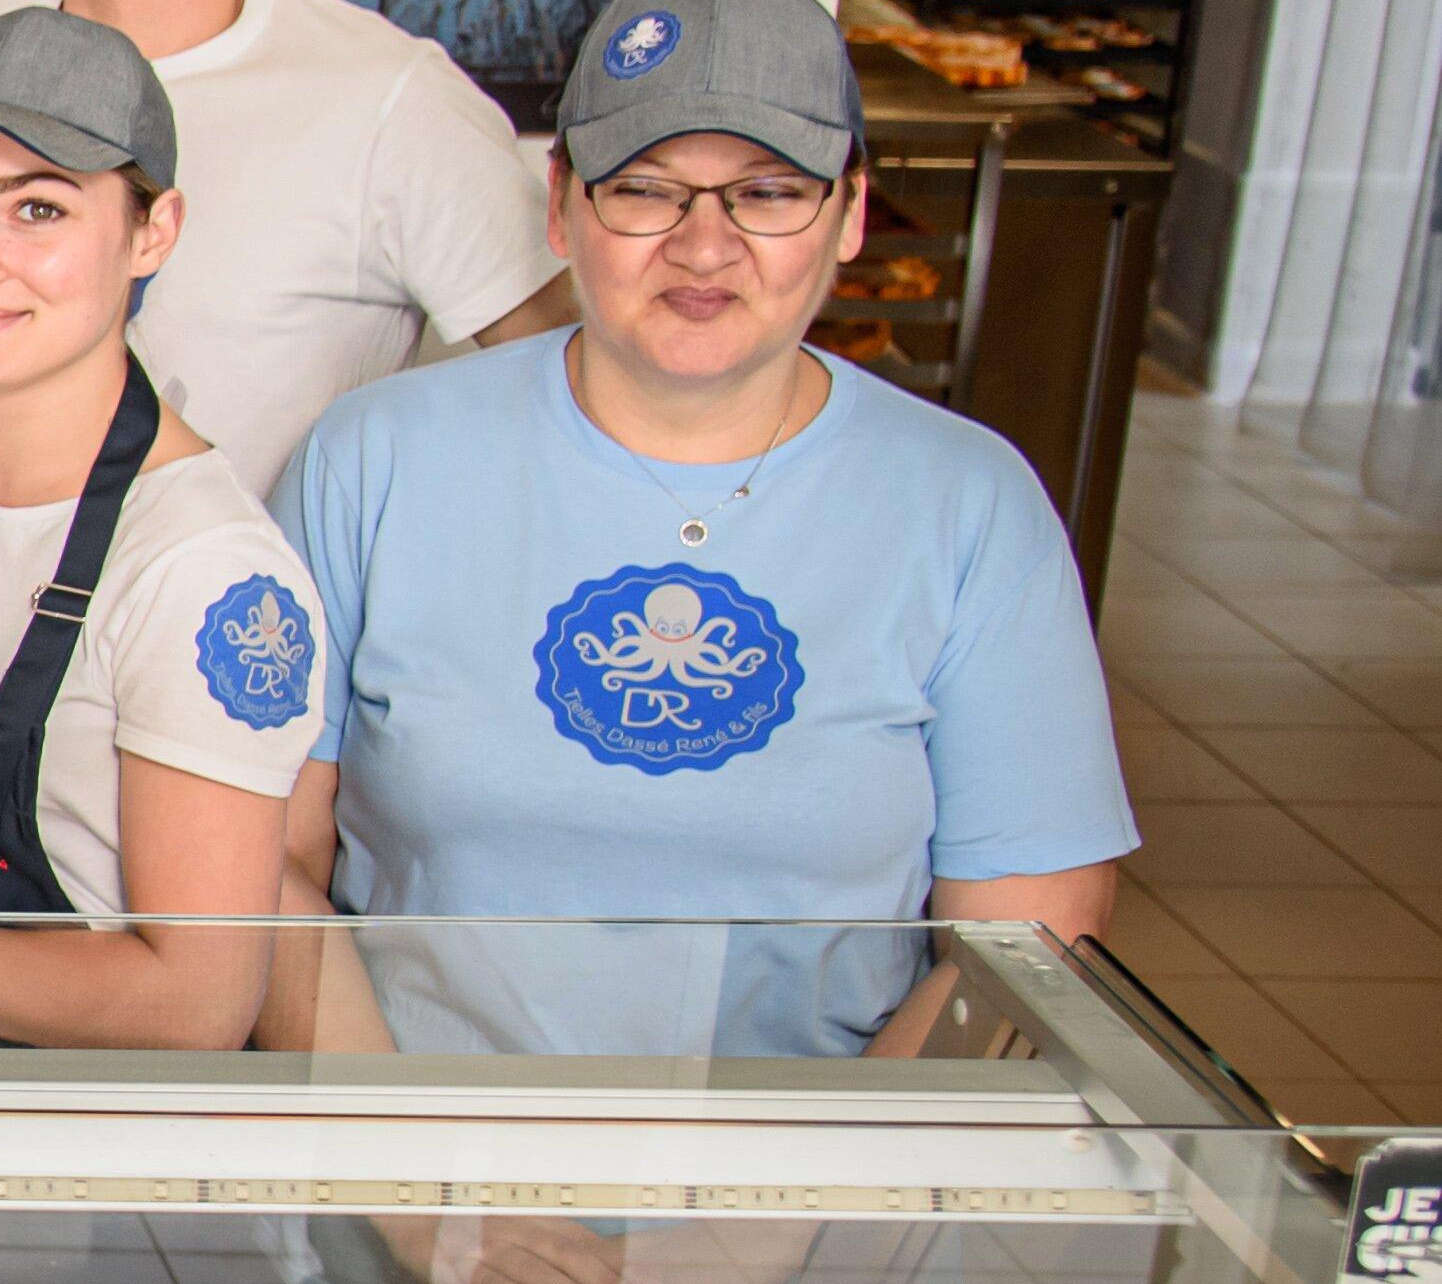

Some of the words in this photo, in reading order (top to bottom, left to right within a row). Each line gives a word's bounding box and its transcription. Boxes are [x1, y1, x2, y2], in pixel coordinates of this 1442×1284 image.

[567, 686, 606, 736] Tielles
[606, 726, 669, 753] Dassé
[675, 728, 729, 754] René
[727, 715, 746, 734] &
[742, 699, 769, 724] fils
[619, 687, 702, 731] DR
